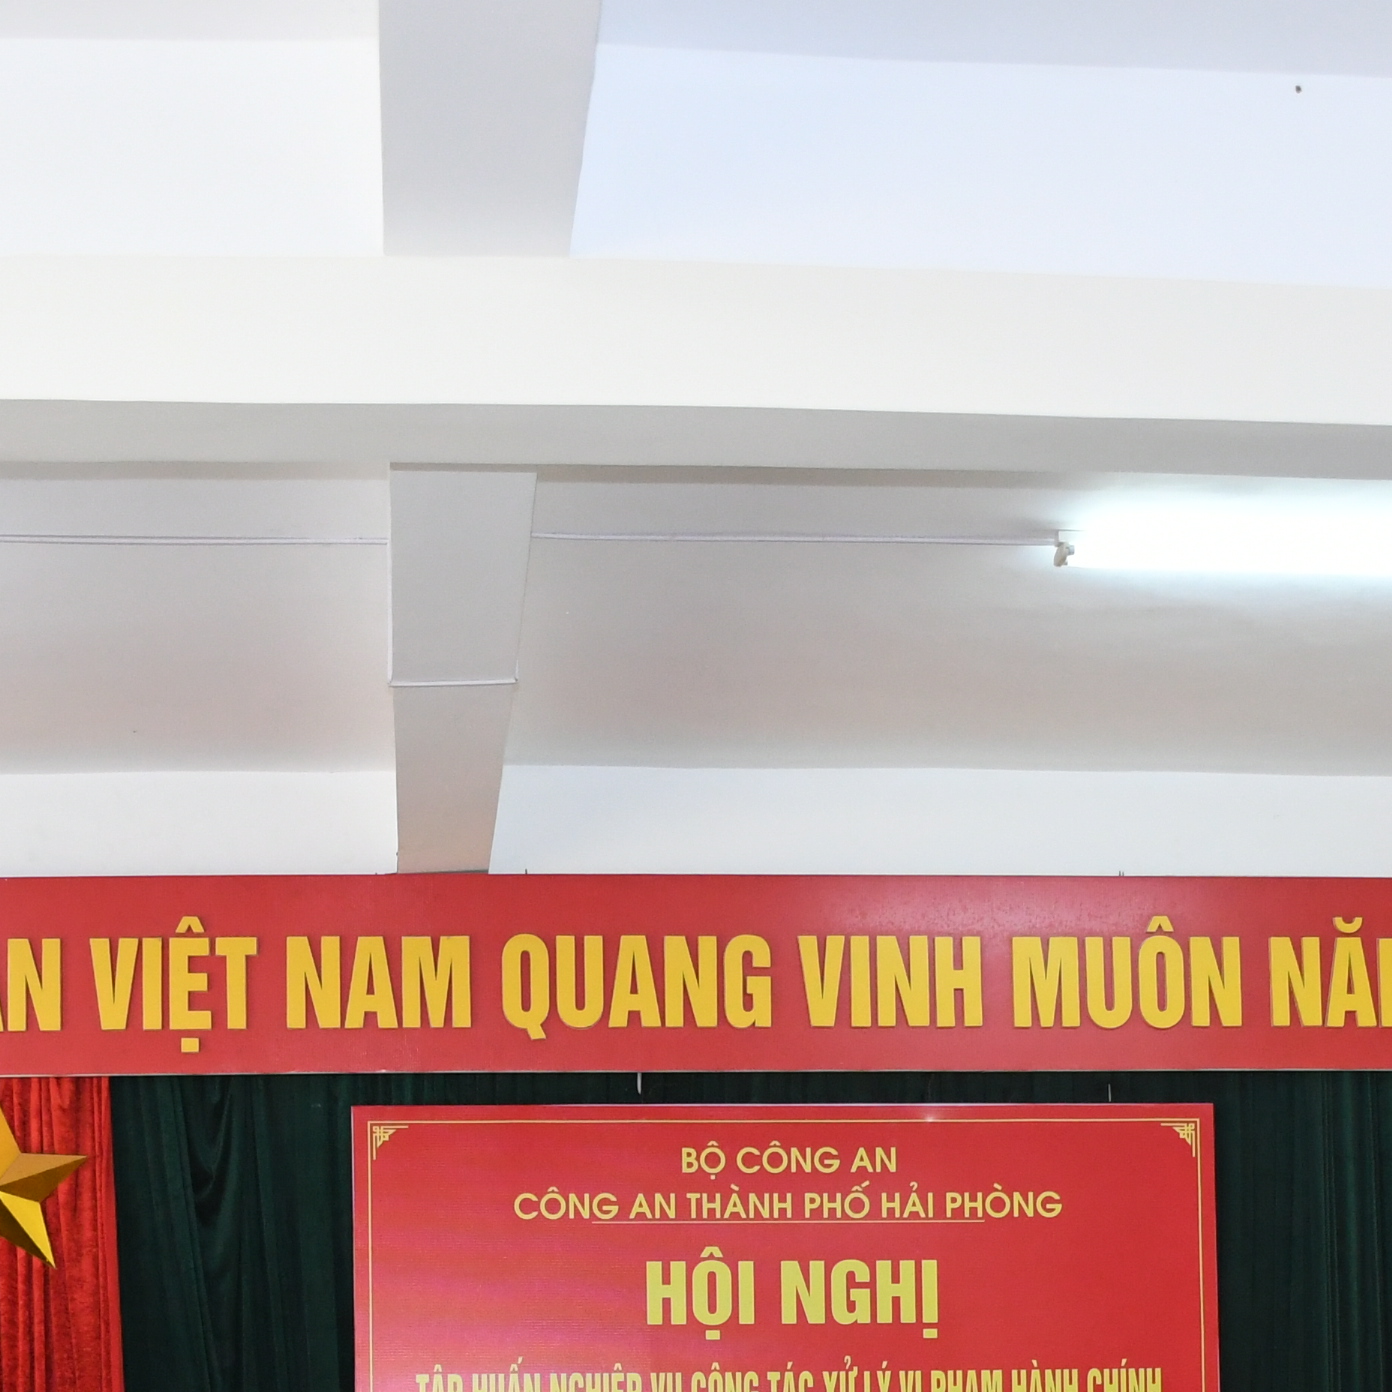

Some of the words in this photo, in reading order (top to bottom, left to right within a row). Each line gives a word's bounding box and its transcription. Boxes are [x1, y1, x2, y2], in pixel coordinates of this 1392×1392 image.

[90, 916, 258, 1052] VIỆT
[287, 936, 472, 1029] NAM
[502, 934, 772, 1039] QUANG
[799, 936, 983, 1027] VINH
[1013, 916, 1243, 1028] MUÔN
[681, 1140, 726, 1180] BỘ
[736, 1140, 841, 1174] CÔNG
[850, 1146, 897, 1173] AN
[513, 1186, 619, 1220] CÔNG
[629, 1192, 676, 1219] AN
[686, 1183, 792, 1219] THÀNH
[805, 1180, 870, 1219] PHỐ
[881, 1181, 934, 1219] HẢI
[945, 1190, 1063, 1219] PHÒNG
[645, 1245, 755, 1340] HỘI
[780, 1259, 939, 1339] NGHỊ
